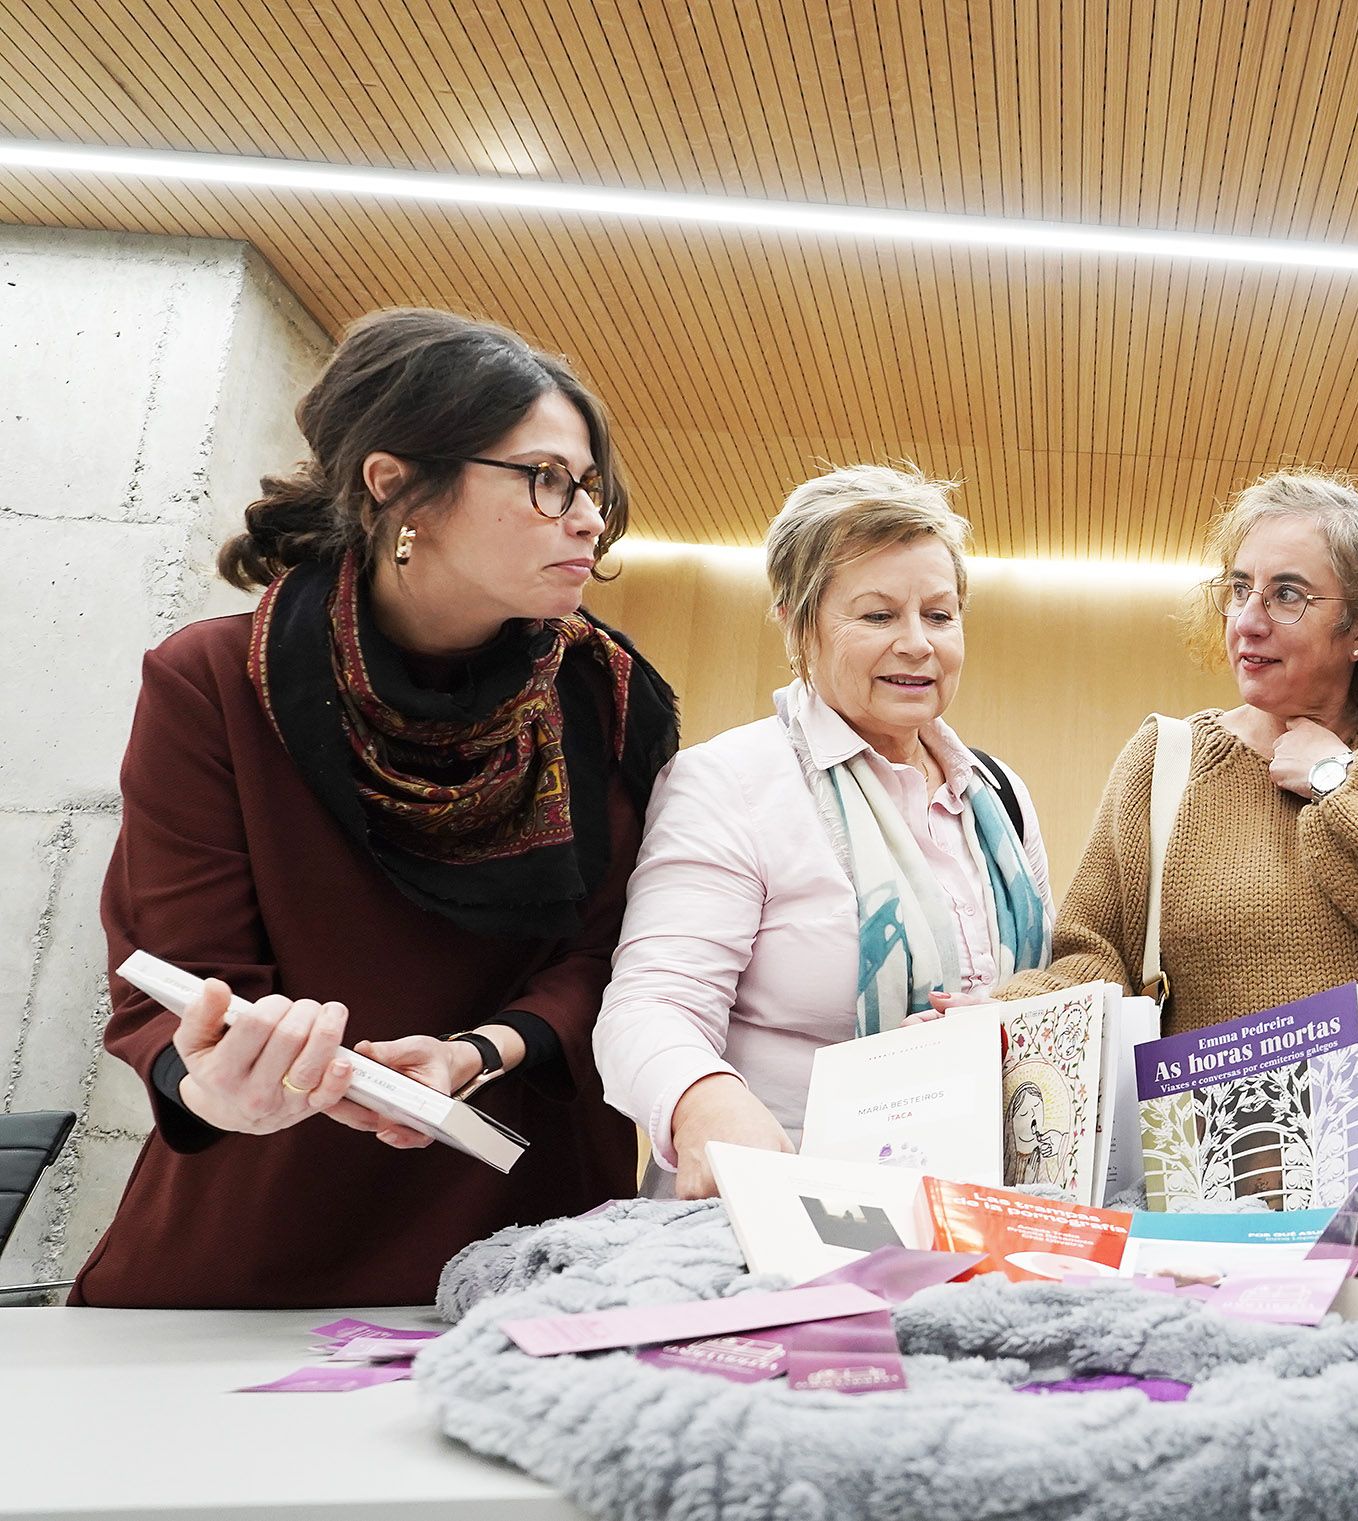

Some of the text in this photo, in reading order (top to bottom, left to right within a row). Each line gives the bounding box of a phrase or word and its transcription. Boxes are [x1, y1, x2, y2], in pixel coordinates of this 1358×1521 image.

[1198, 1014, 1294, 1050] Emma Pedreira
[1154, 1016, 1342, 1082] As horas mortas
[1160, 1080, 1190, 1093] Viaxes
[1199, 1067, 1241, 1085] conversas
[1242, 1065, 1258, 1078] por
[1259, 1051, 1304, 1069] cemiterios
[1306, 1040, 1339, 1058] galegos
[890, 1090, 945, 1109] BESTEIROS
[952, 1197, 979, 1208] de
[984, 1201, 1003, 1212] la
[973, 1192, 1101, 1222] Las trampas
